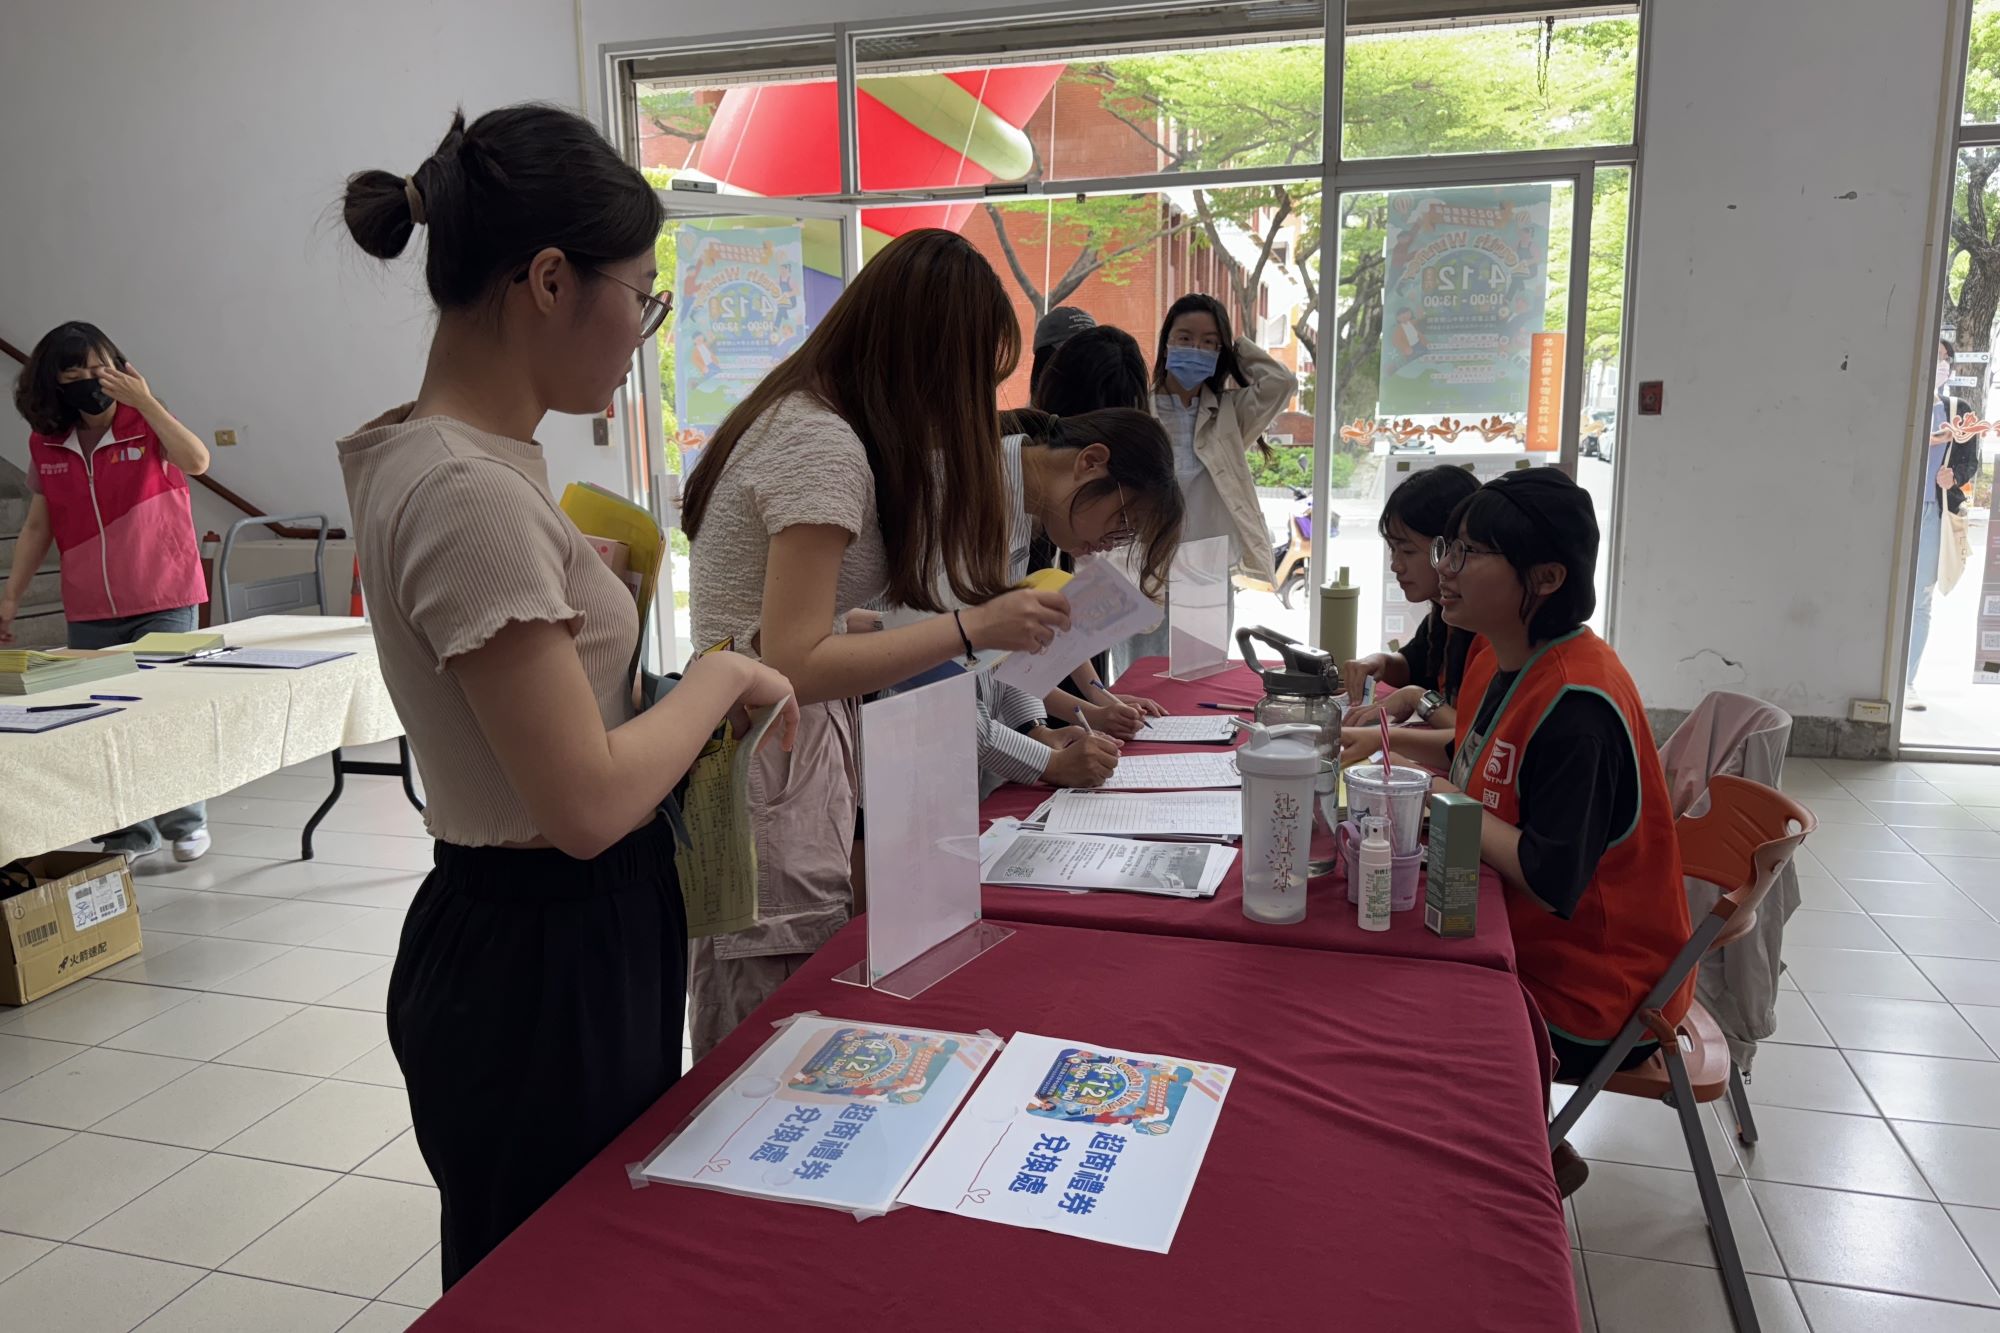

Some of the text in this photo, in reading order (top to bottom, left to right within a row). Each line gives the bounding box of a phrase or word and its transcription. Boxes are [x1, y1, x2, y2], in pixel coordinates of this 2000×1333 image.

[69, 941, 108, 967] 火箭速配
[1062, 1082, 1080, 1101] 13:00
[1080, 1065, 1119, 1099] 4 12
[748, 1104, 822, 1163] 兌換處
[792, 1102, 878, 1180] 超商禮券
[1008, 1133, 1071, 1195] 兌換處
[1057, 1131, 1128, 1215] 超商禮券
